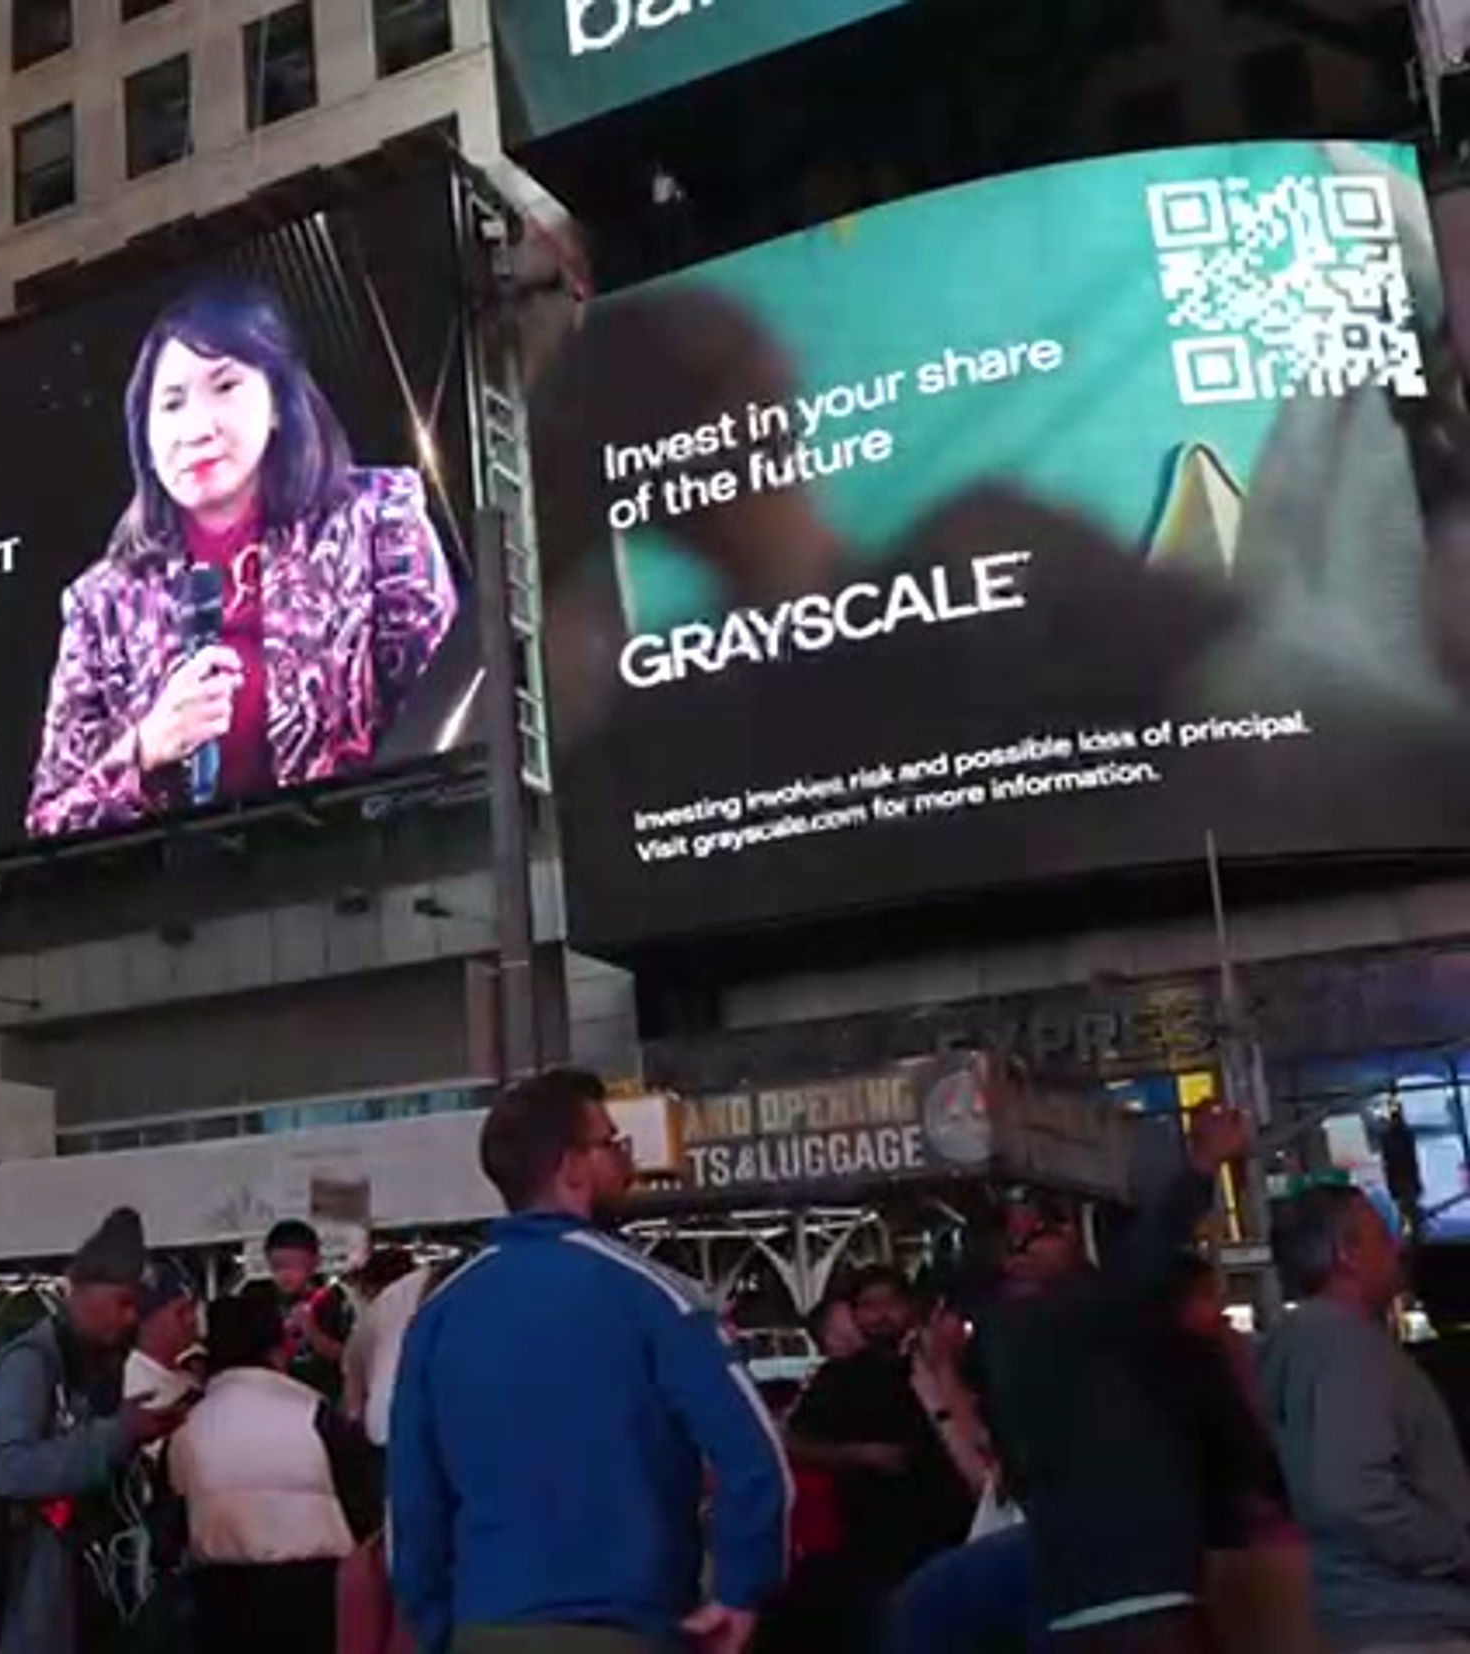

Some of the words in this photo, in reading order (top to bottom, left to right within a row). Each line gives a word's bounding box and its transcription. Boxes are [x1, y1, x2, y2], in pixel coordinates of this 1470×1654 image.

[602, 412, 737, 481] Invest
[747, 402, 790, 442] in
[797, 371, 904, 436] your
[916, 338, 1064, 395] share
[608, 487, 660, 531] of
[664, 467, 737, 516] the
[748, 428, 894, 492] future
[619, 552, 1030, 689] GRAYSCALE
[634, 797, 741, 831] Investing
[849, 762, 894, 790] risk
[898, 753, 948, 781] and
[954, 735, 1073, 777] possible
[1143, 720, 1171, 746] of
[1180, 710, 1311, 748] principal.
[636, 836, 688, 862] Visit
[693, 804, 867, 858] grayscale.com
[873, 795, 907, 819] for
[915, 785, 985, 812] more
[990, 761, 1162, 799] information.
[686, 1125, 925, 1188] TS&LUGGAGE
